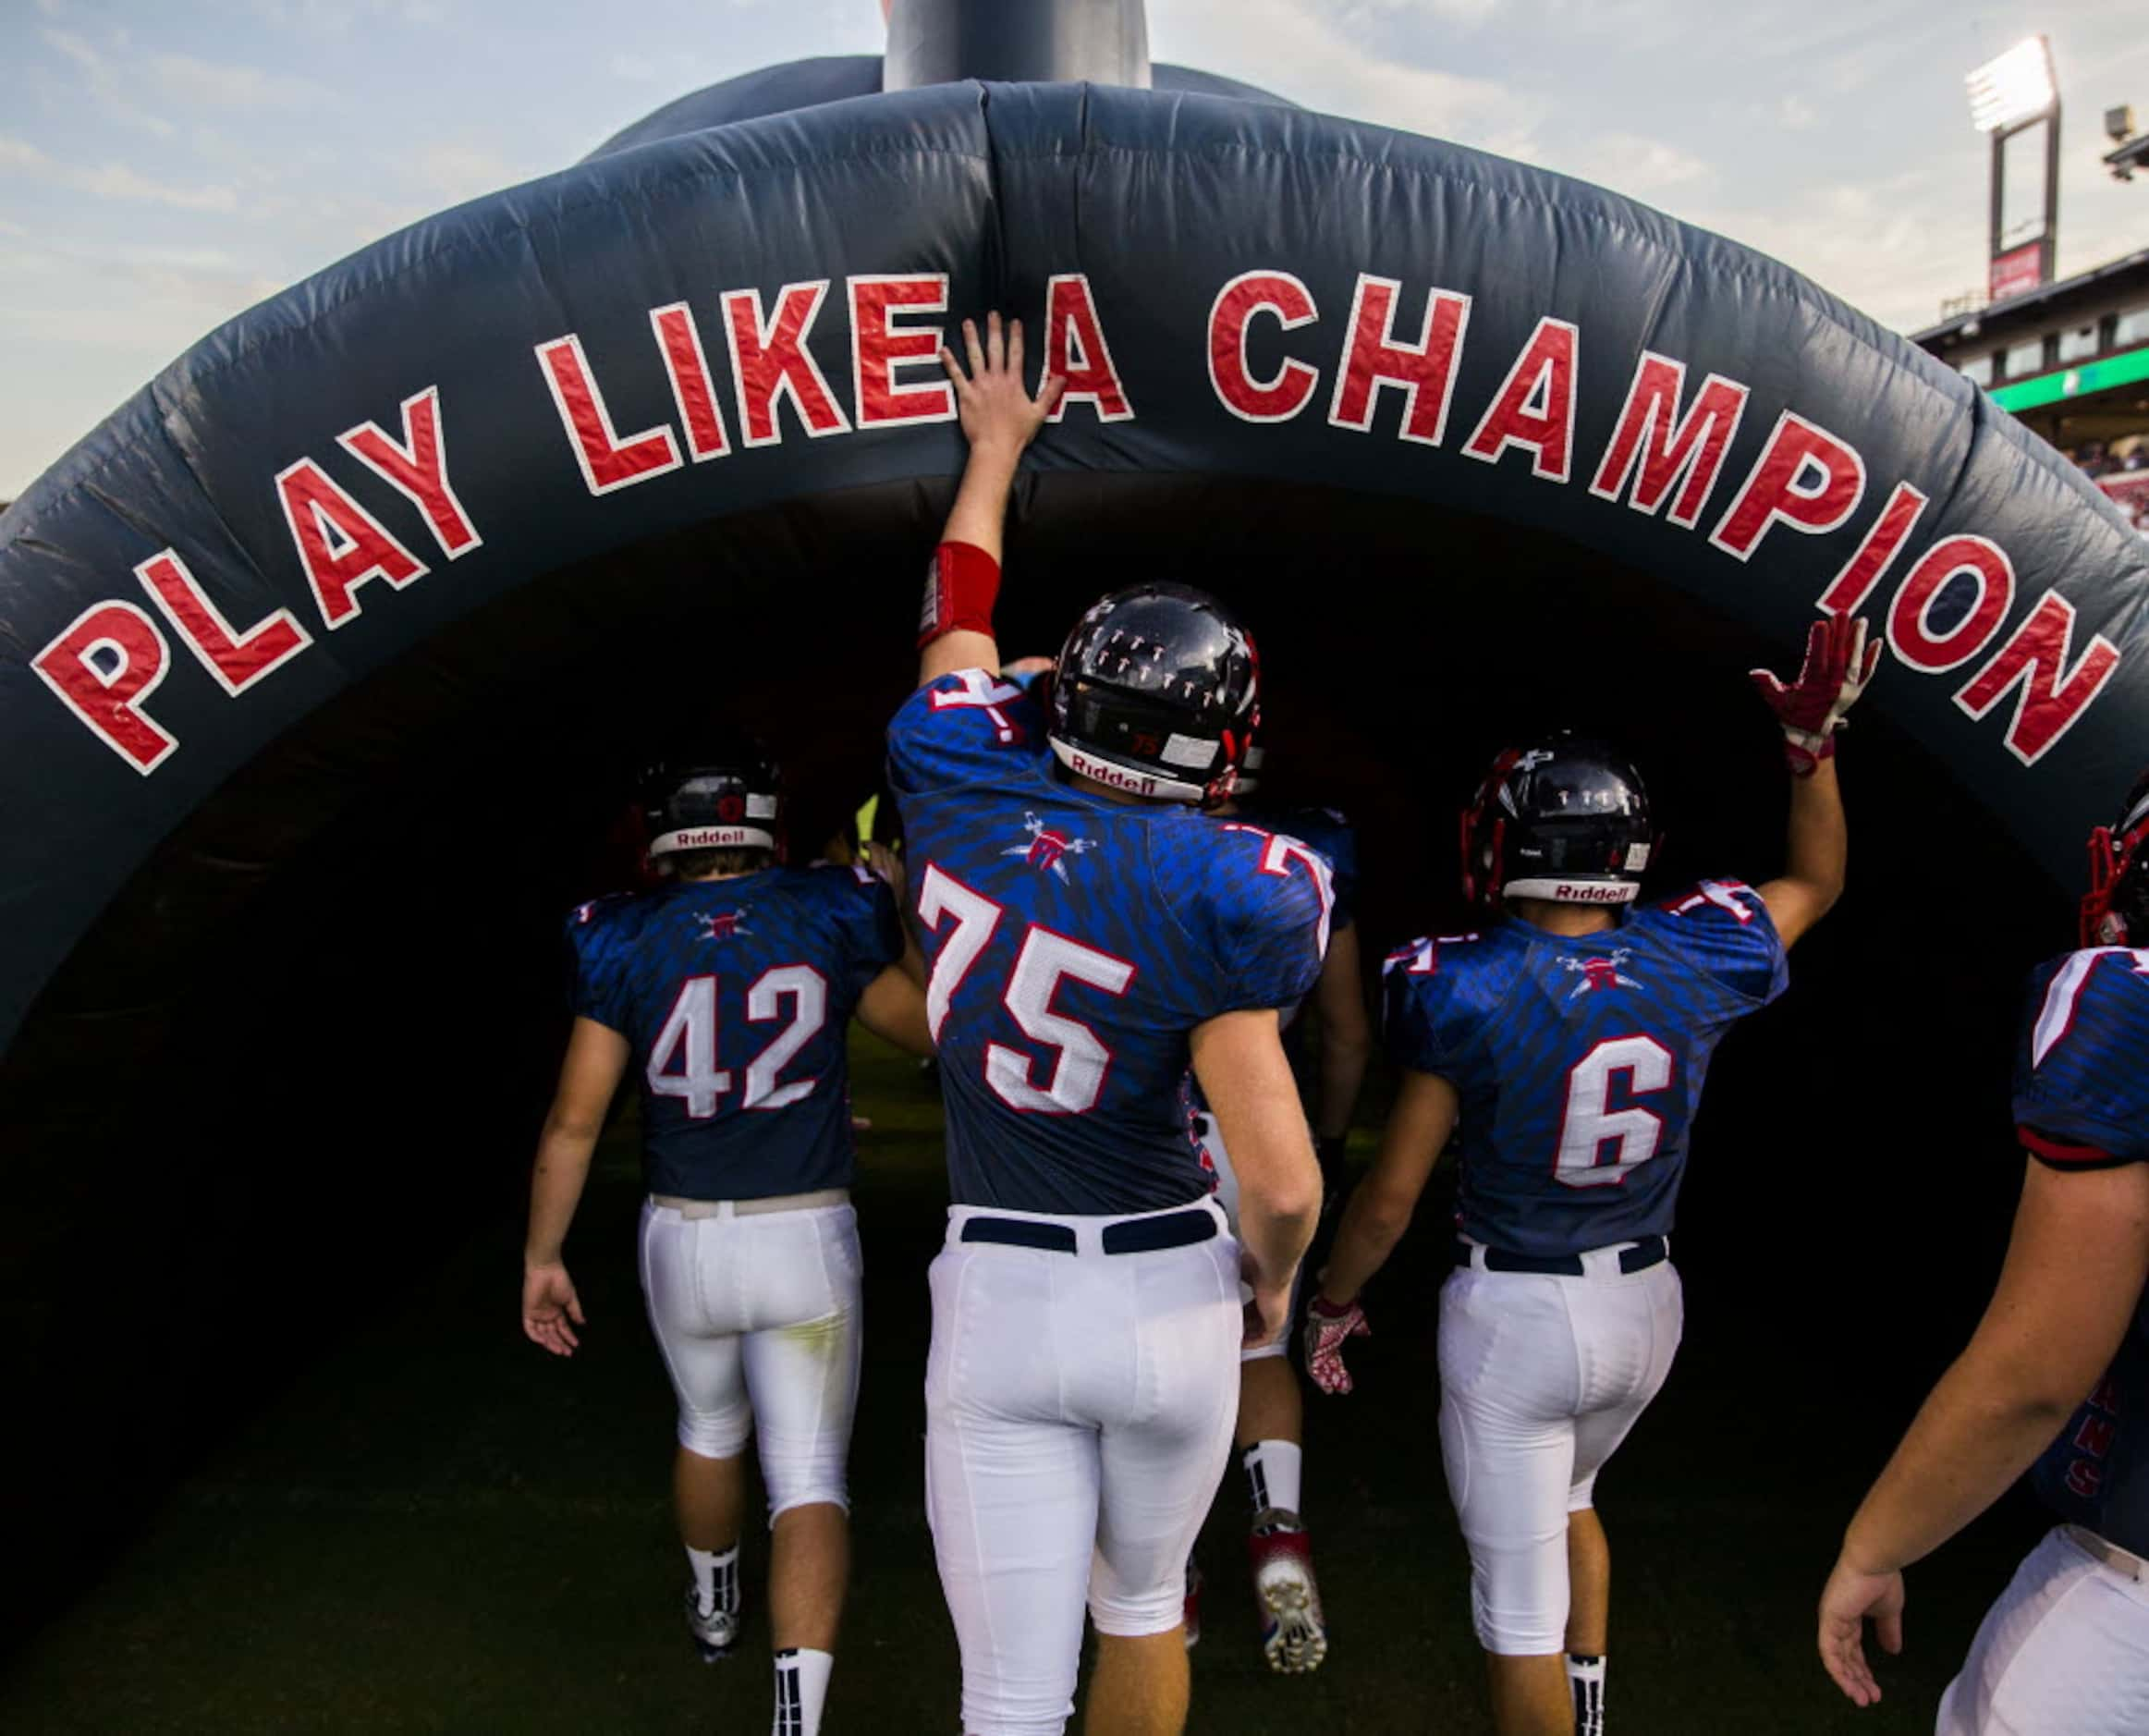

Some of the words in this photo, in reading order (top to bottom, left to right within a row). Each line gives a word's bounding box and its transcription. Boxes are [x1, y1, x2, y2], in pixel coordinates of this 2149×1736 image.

[30, 385, 482, 776] PLAY
[534, 274, 959, 496] LIKE
[1037, 274, 1136, 423] A
[1207, 270, 2120, 767] CHAMPION
[677, 830, 744, 846] Riddell
[1072, 753, 1155, 795] Riddell
[1556, 885, 1629, 901] Riddell
[646, 962, 827, 1118] 42
[917, 860, 1137, 1113] 75
[1554, 1033, 1675, 1187] 6
